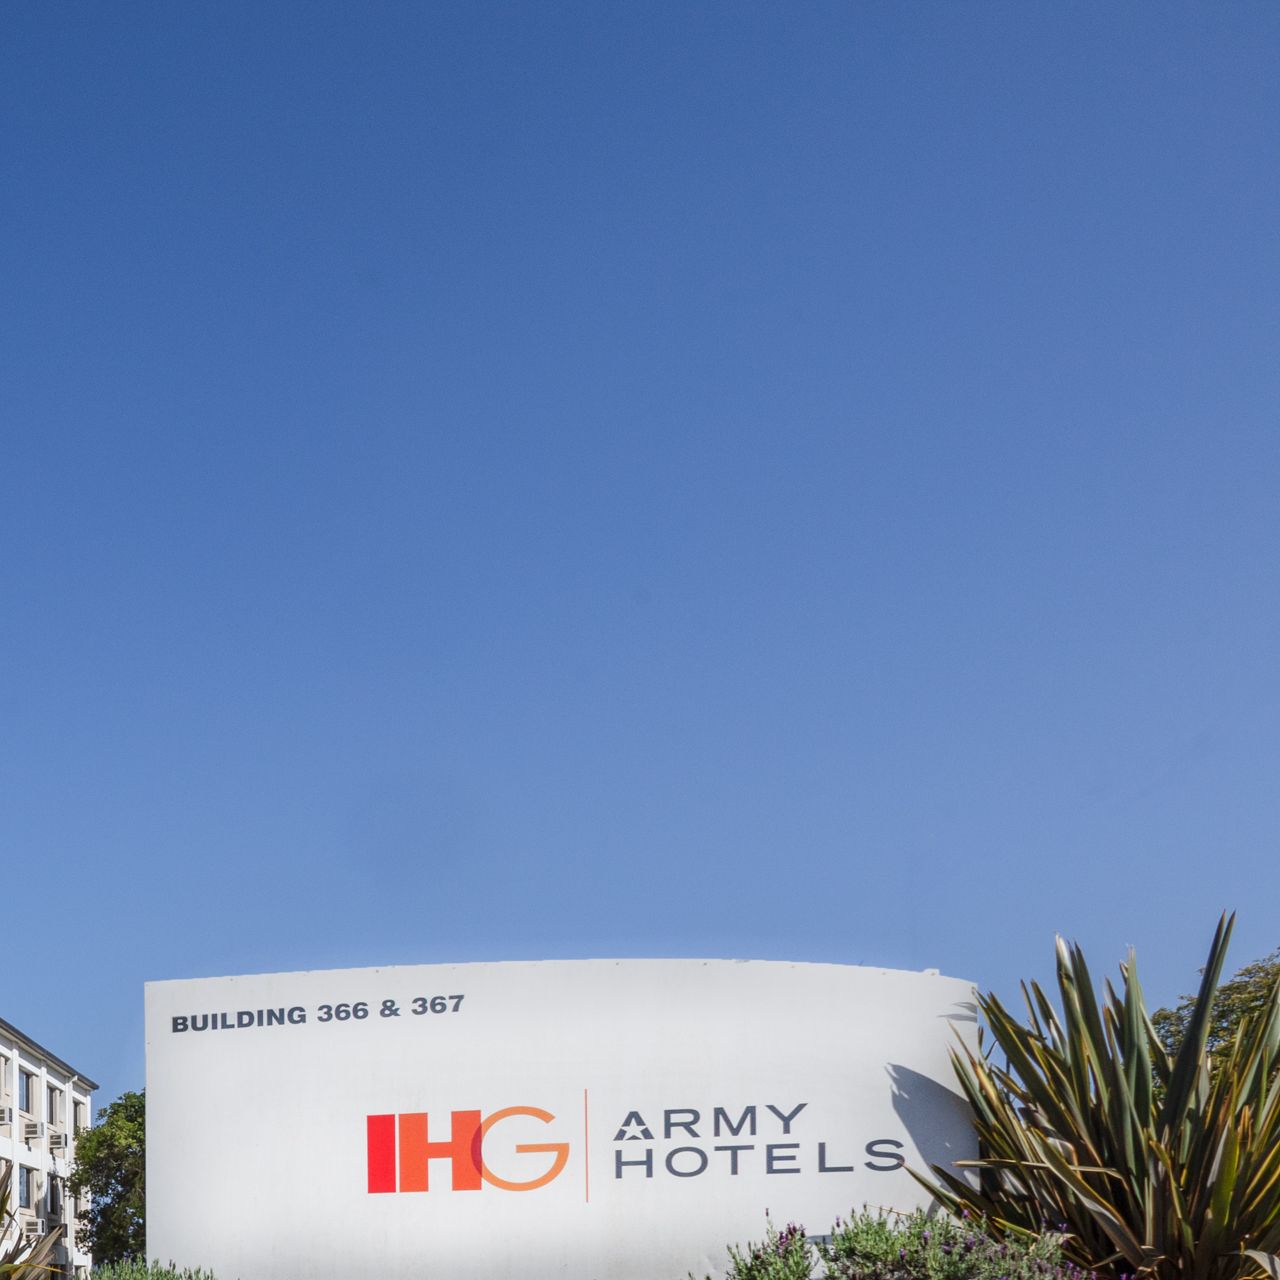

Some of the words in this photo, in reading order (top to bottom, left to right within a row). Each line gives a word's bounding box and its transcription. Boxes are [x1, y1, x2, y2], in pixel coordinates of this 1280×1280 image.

[171, 1006, 307, 1034] BUILDING
[317, 1001, 369, 1023] 366
[379, 999, 401, 1018] &
[411, 994, 465, 1016] 367
[613, 1103, 808, 1141] ARMY
[367, 1105, 570, 1195] IHG
[615, 1138, 906, 1179] HOTELS
